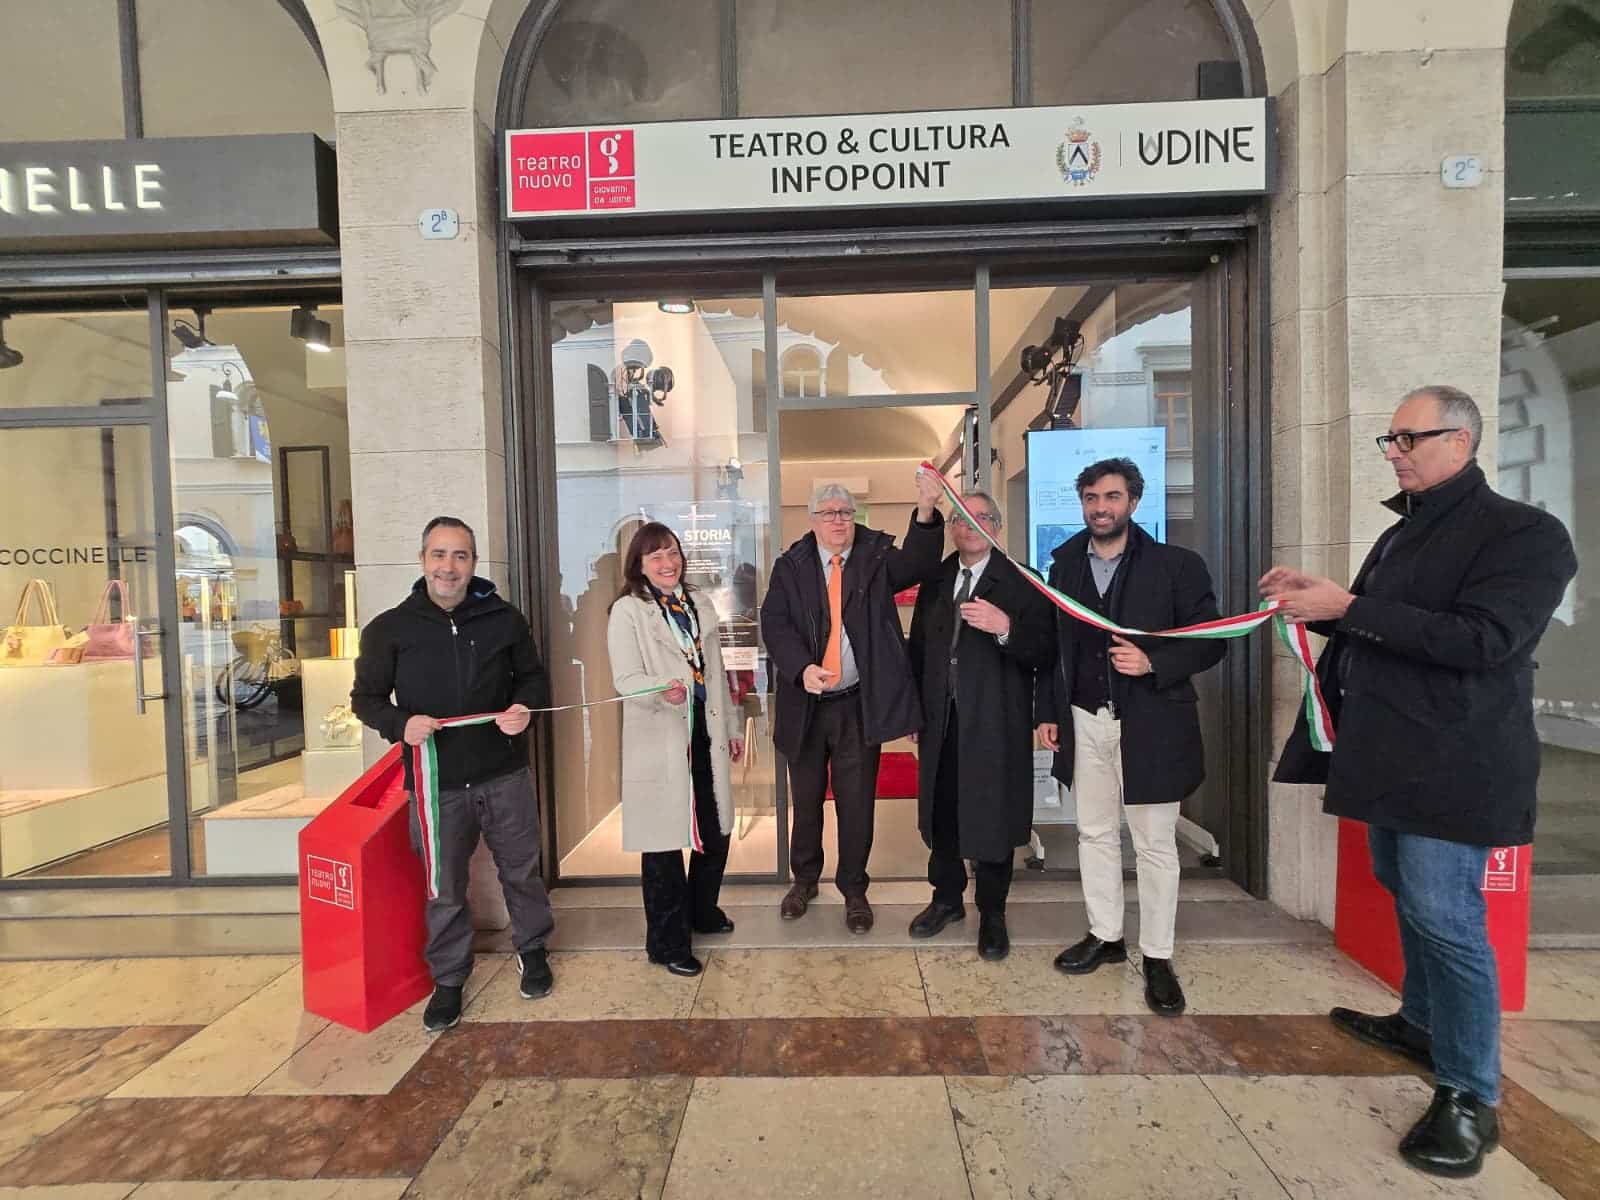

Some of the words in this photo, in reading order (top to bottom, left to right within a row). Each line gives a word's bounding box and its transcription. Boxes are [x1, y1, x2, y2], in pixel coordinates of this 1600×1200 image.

[709, 130, 828, 158] TEATRO
[836, 128, 859, 154] &
[868, 123, 1011, 153] CULTURA
[1138, 126, 1255, 166] UDINE
[771, 160, 951, 193] INFOPOINT
[684, 529, 732, 542] STORIA
[0, 546, 147, 565] COCCINELLE
